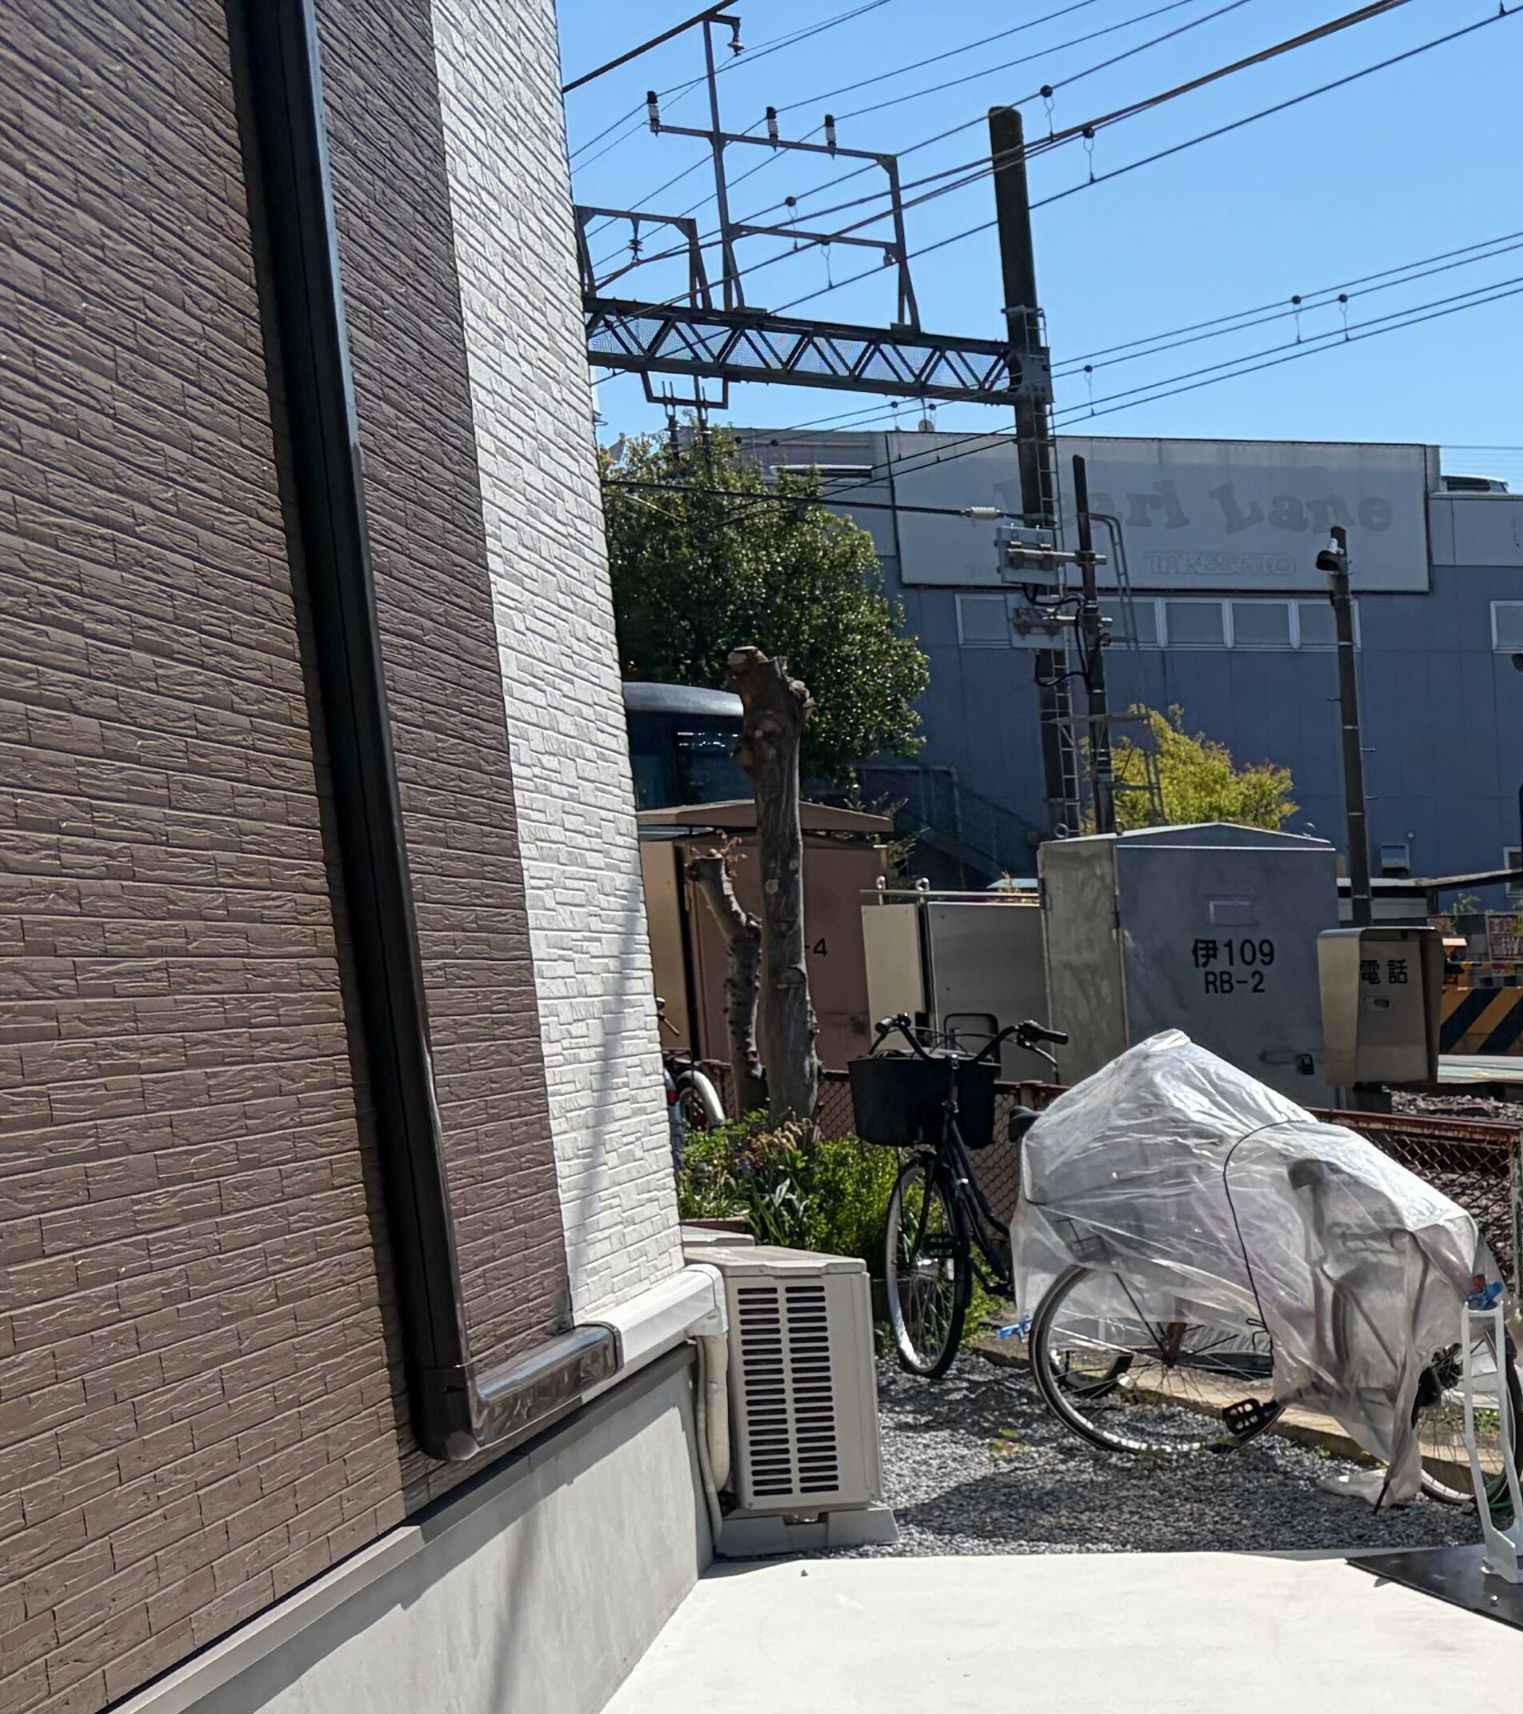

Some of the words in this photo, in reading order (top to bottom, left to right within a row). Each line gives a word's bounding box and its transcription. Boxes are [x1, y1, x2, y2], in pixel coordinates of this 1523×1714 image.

[1211, 482, 1393, 534] Lane
[1192, 939, 1274, 968] 伊109
[1205, 971, 1264, 993] RB-2
[1360, 960, 1407, 984] 電話
